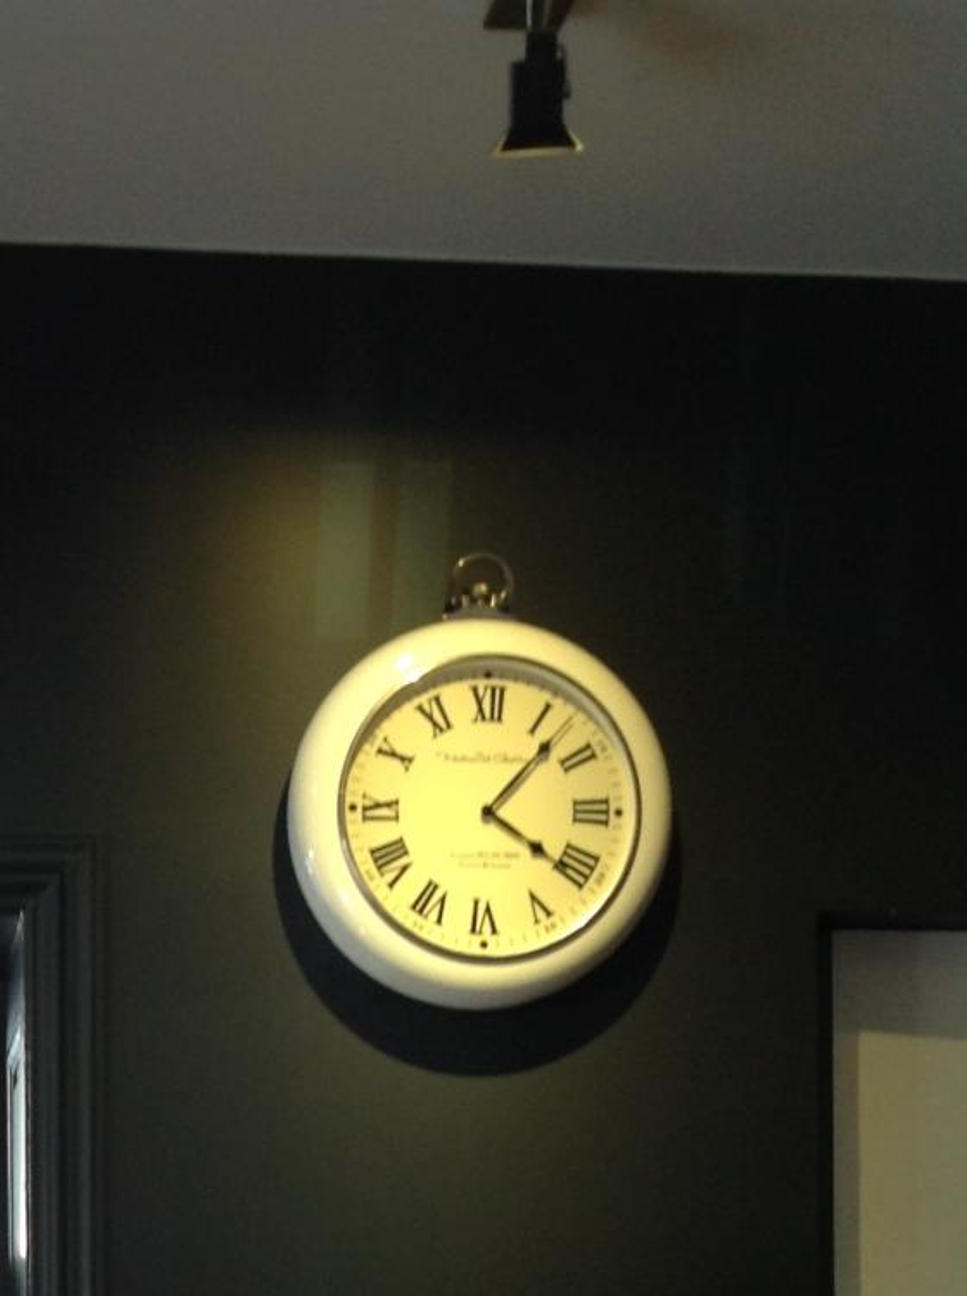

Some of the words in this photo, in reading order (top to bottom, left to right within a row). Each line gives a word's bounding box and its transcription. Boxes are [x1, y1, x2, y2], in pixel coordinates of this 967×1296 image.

[416, 695, 452, 738] XI
[470, 685, 505, 722] XII
[528, 702, 552, 735] I
[375, 737, 414, 772] X
[559, 742, 597, 773] II
[362, 793, 399, 822] IX
[572, 798, 610, 827] III
[369, 836, 413, 889] VIII
[410, 879, 447, 925] VII
[470, 898, 498, 935] VI
[529, 889, 553, 925] V
